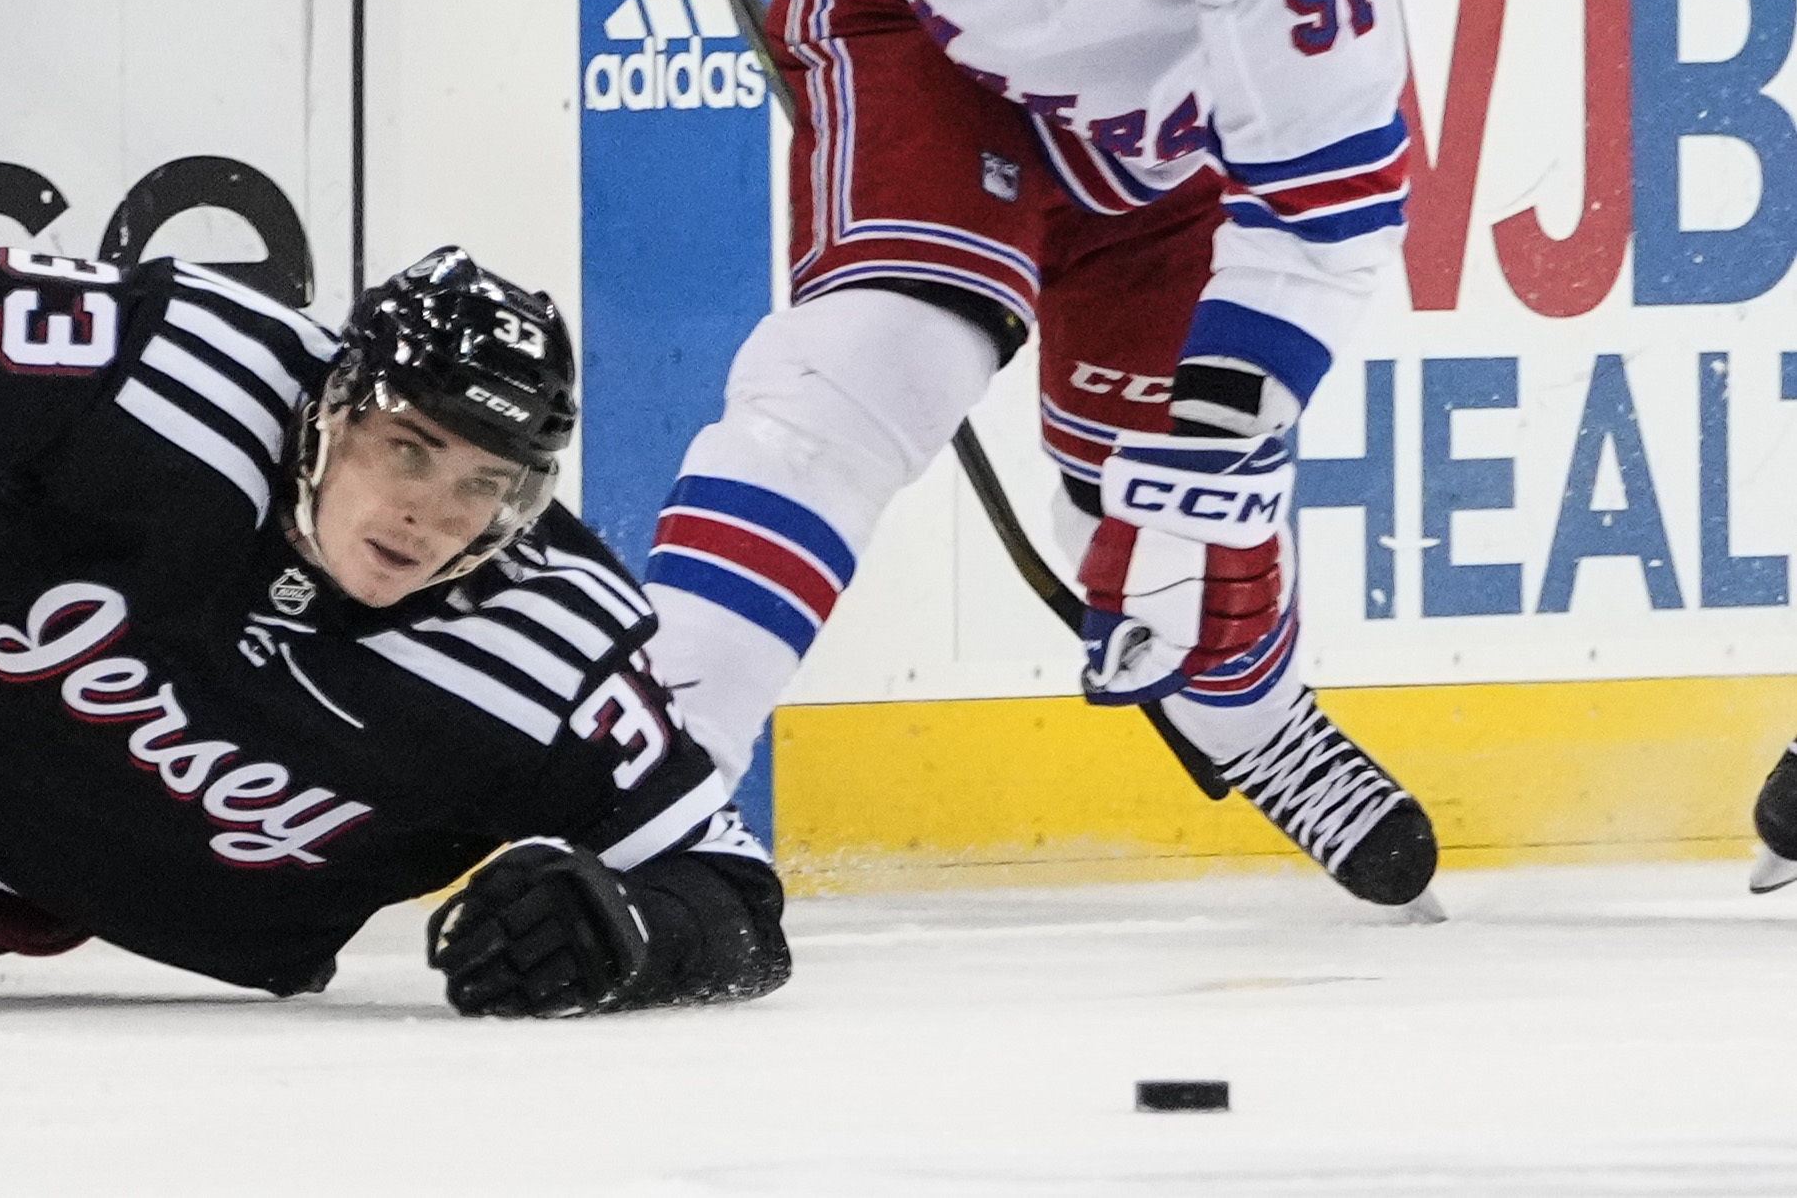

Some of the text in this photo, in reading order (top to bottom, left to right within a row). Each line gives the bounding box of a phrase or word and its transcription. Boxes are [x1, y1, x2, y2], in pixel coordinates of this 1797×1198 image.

[584, 36, 768, 112] adidas
[493, 310, 546, 360] 33
[464, 384, 531, 423] CCM
[1121, 478, 1283, 525] CCM
[1295, 351, 1797, 621] HEAL
